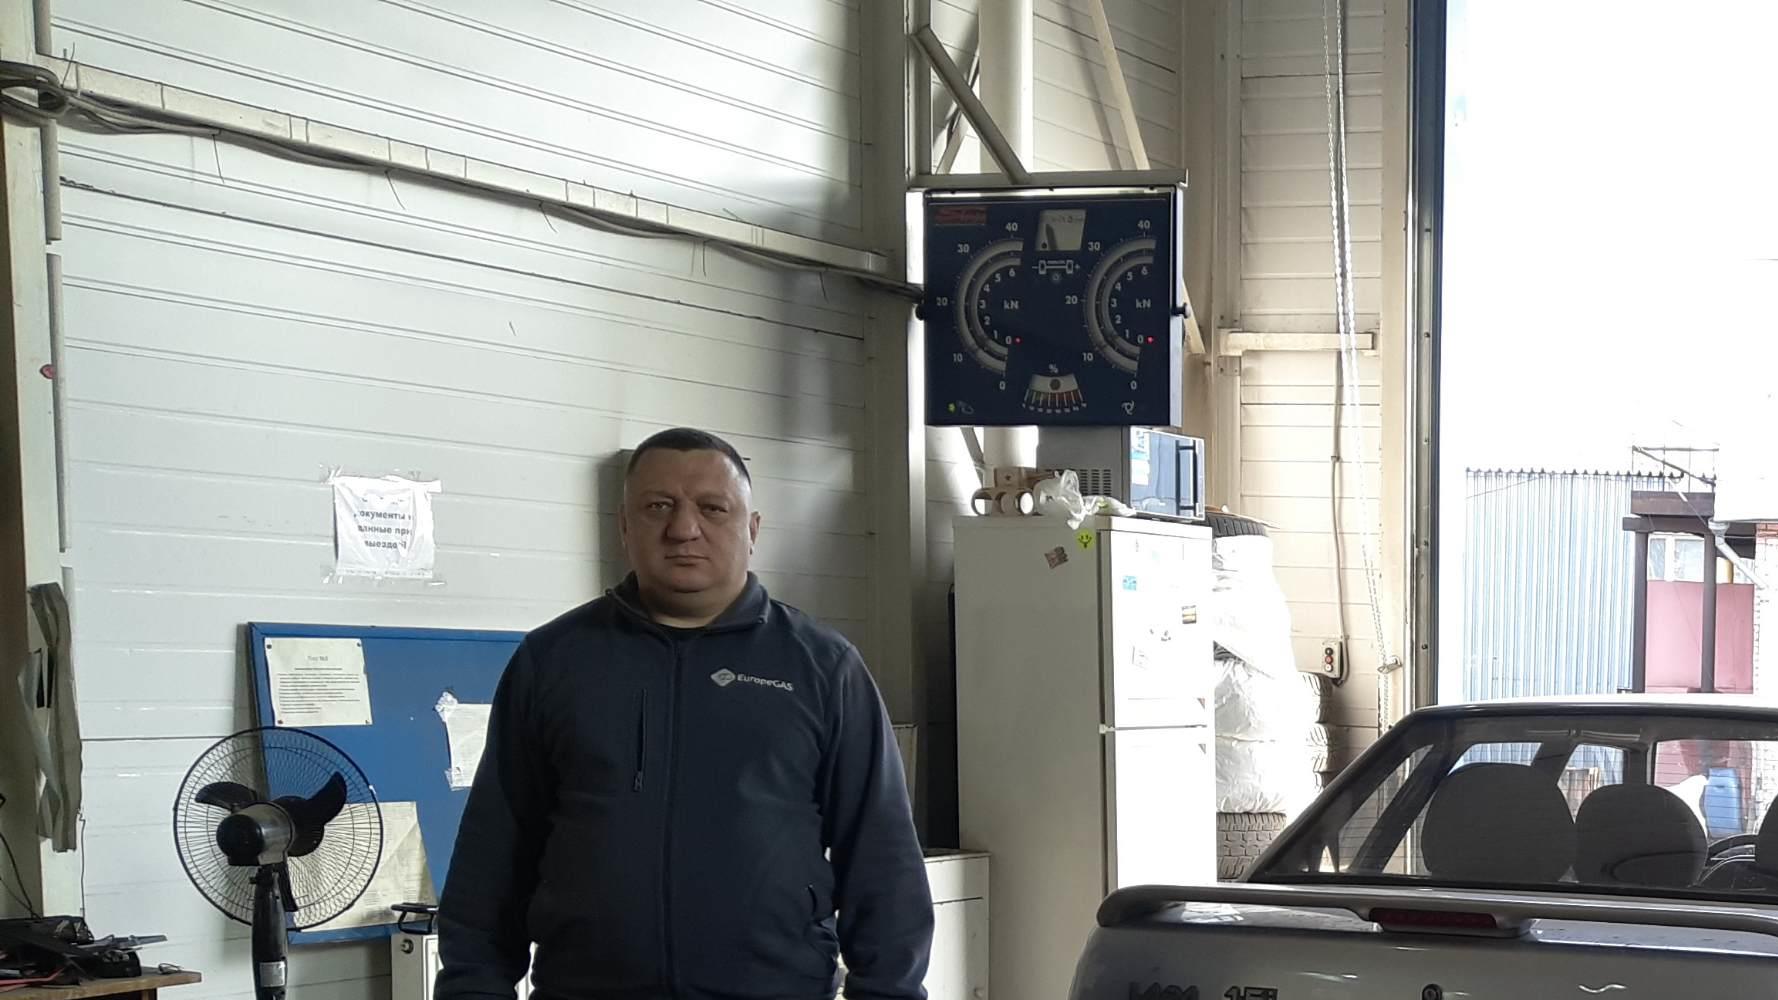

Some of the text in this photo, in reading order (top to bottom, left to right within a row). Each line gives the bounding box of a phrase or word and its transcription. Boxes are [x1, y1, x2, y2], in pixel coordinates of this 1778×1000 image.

[1006, 223, 1018, 232] 40
[1138, 220, 1151, 229] 40
[958, 244, 970, 253] 30
[1088, 242, 1101, 251] 30
[937, 297, 948, 307] 20
[1066, 296, 1078, 305] 20
[1136, 300, 1151, 308] kN
[1004, 301, 1019, 310] kN
[954, 354, 964, 363] 10
[1084, 353, 1094, 362] 10
[353, 510, 405, 520] окументы
[737, 673, 793, 691] EuropeGAS
